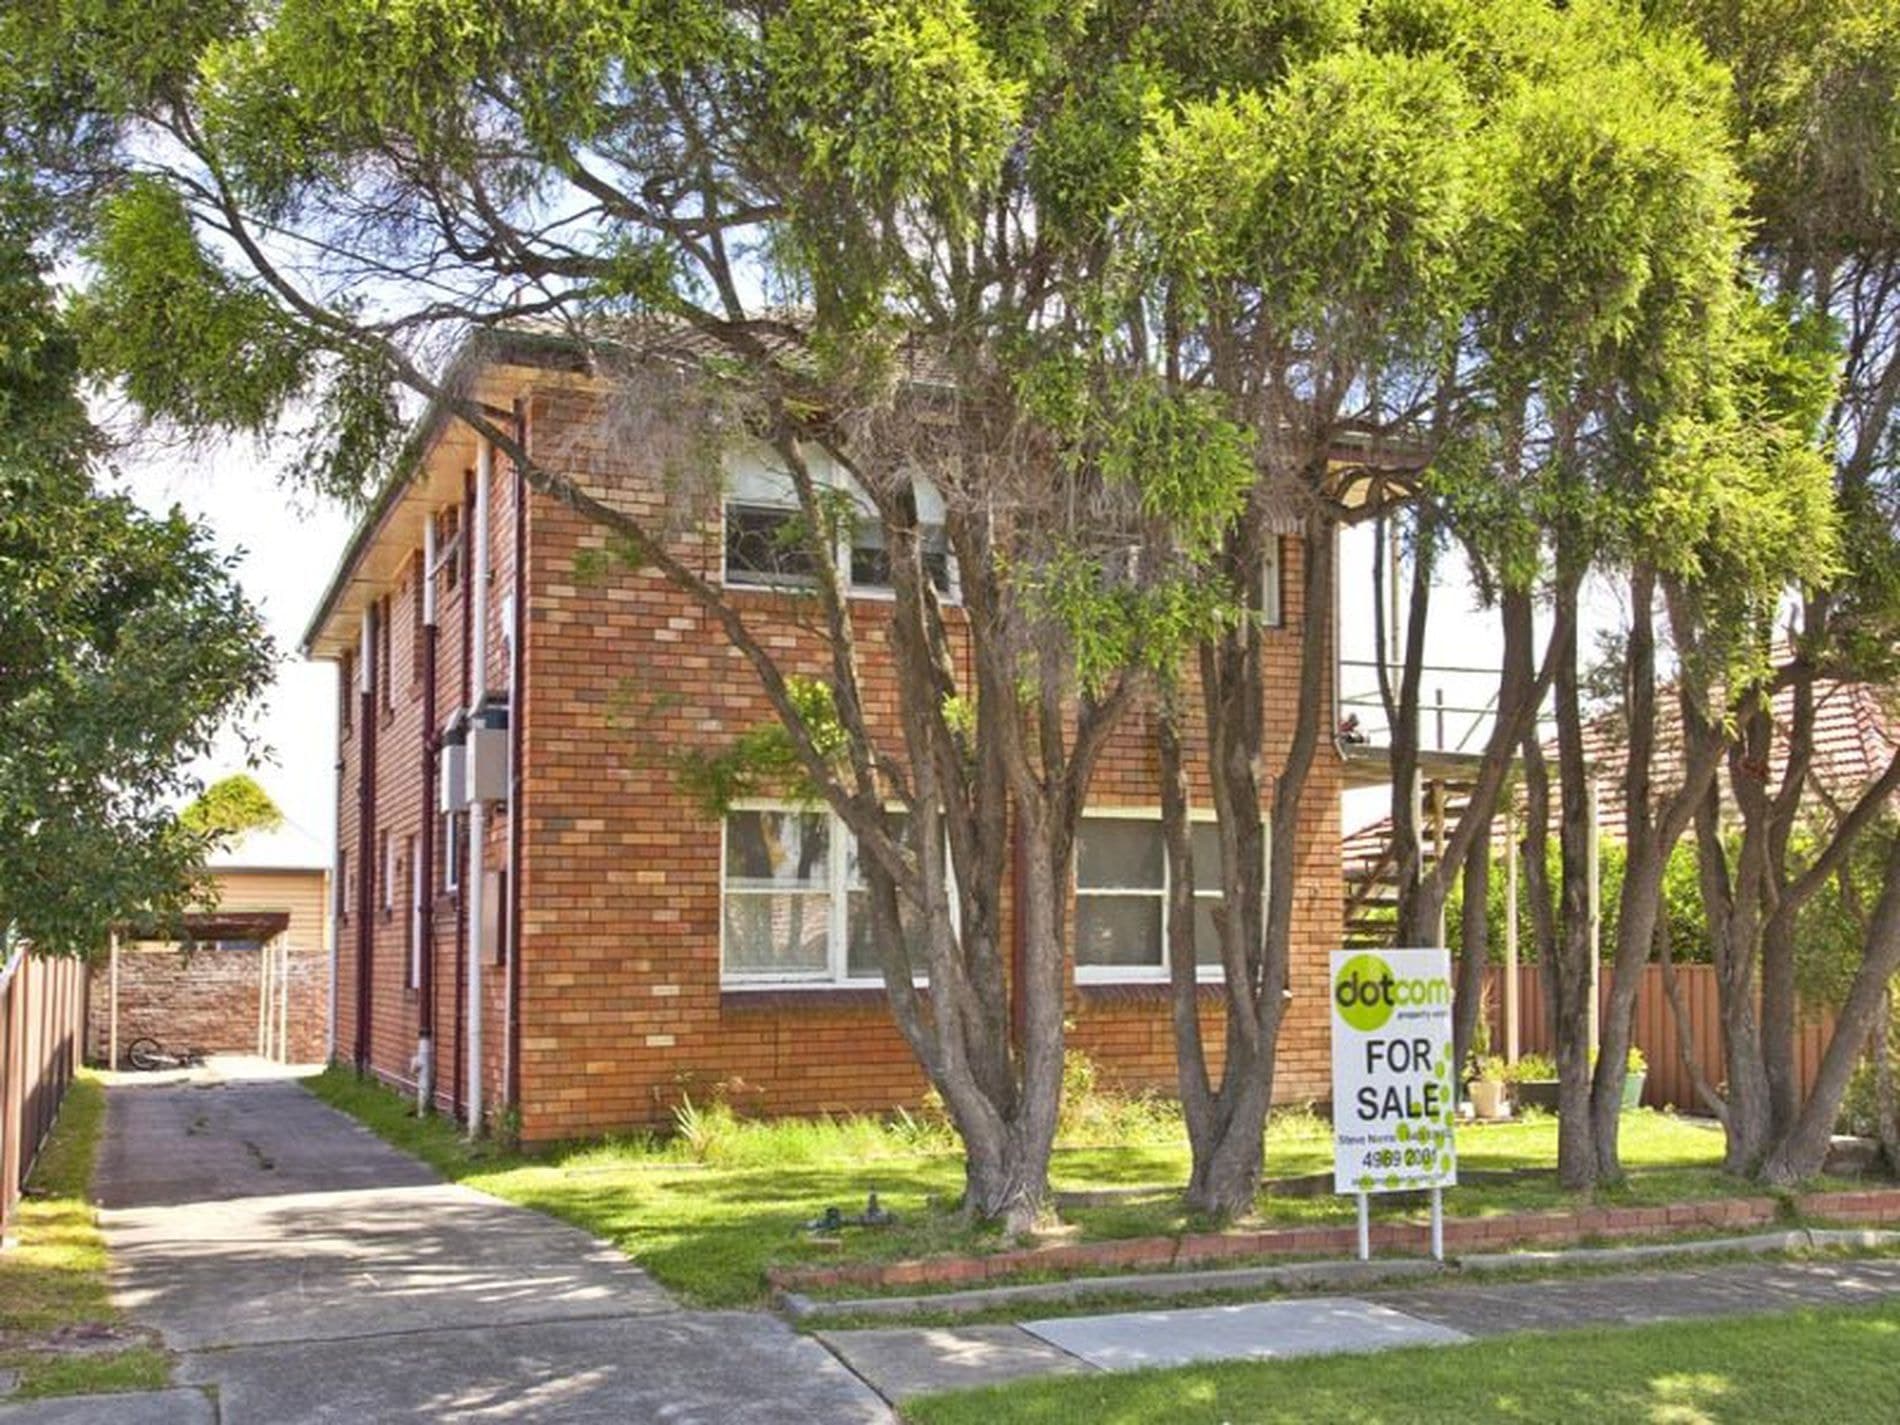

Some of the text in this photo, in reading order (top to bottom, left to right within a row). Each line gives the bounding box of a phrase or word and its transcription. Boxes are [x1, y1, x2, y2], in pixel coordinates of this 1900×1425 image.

[1336, 970, 1449, 1007] dotcom
[1366, 1038, 1432, 1074] FOR
[1357, 1083, 1440, 1121] SALE
